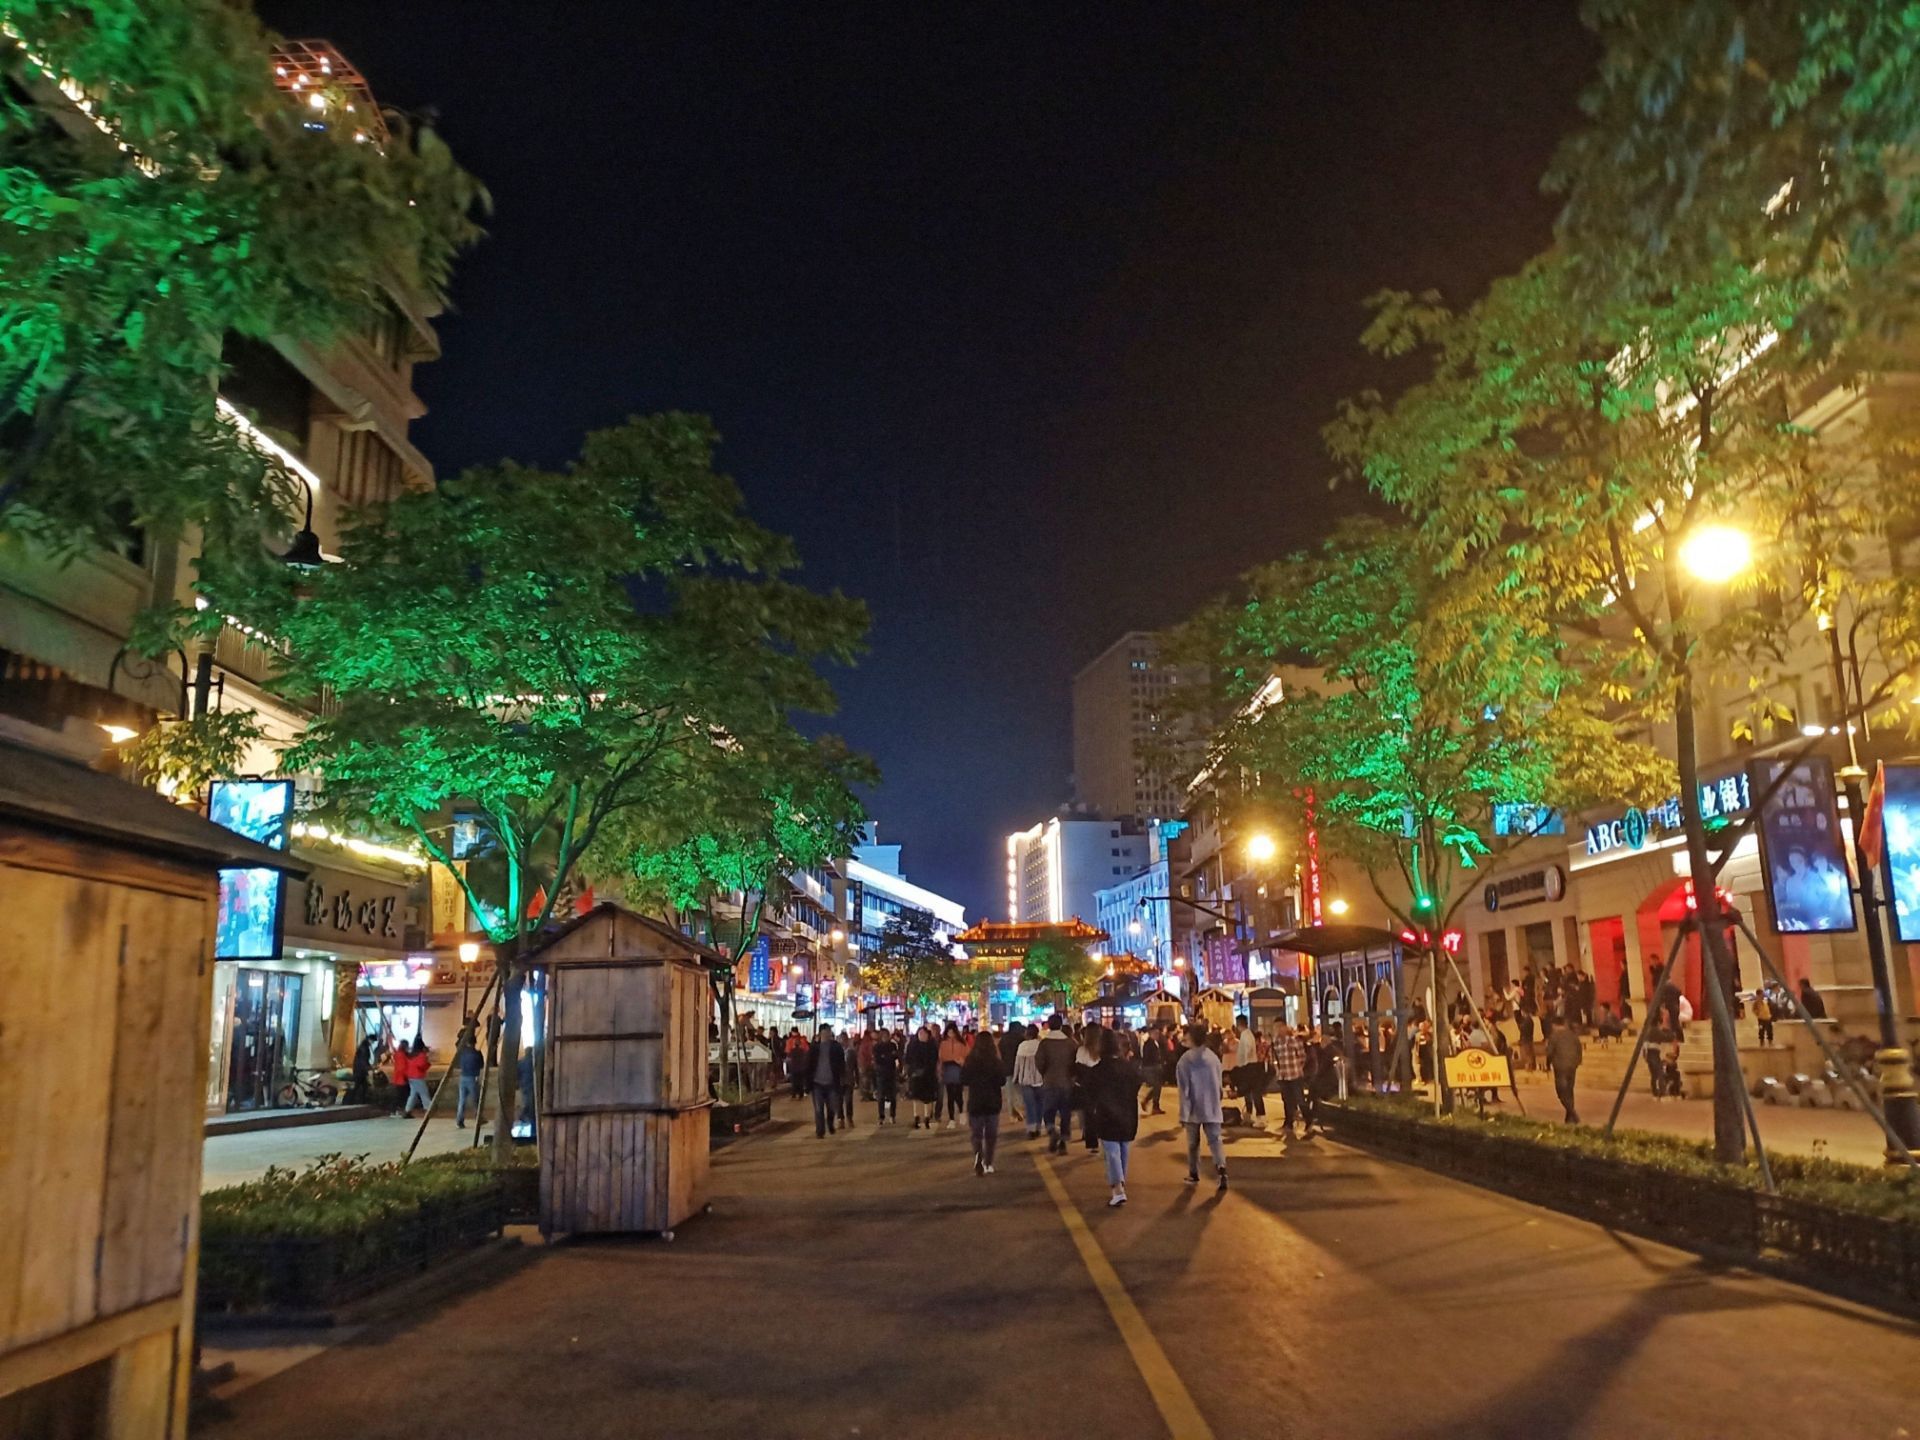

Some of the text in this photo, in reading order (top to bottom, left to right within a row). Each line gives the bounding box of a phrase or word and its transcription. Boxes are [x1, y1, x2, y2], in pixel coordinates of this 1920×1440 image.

[1587, 820, 1622, 855] ABC
[1646, 772, 1750, 829] 中国业银
